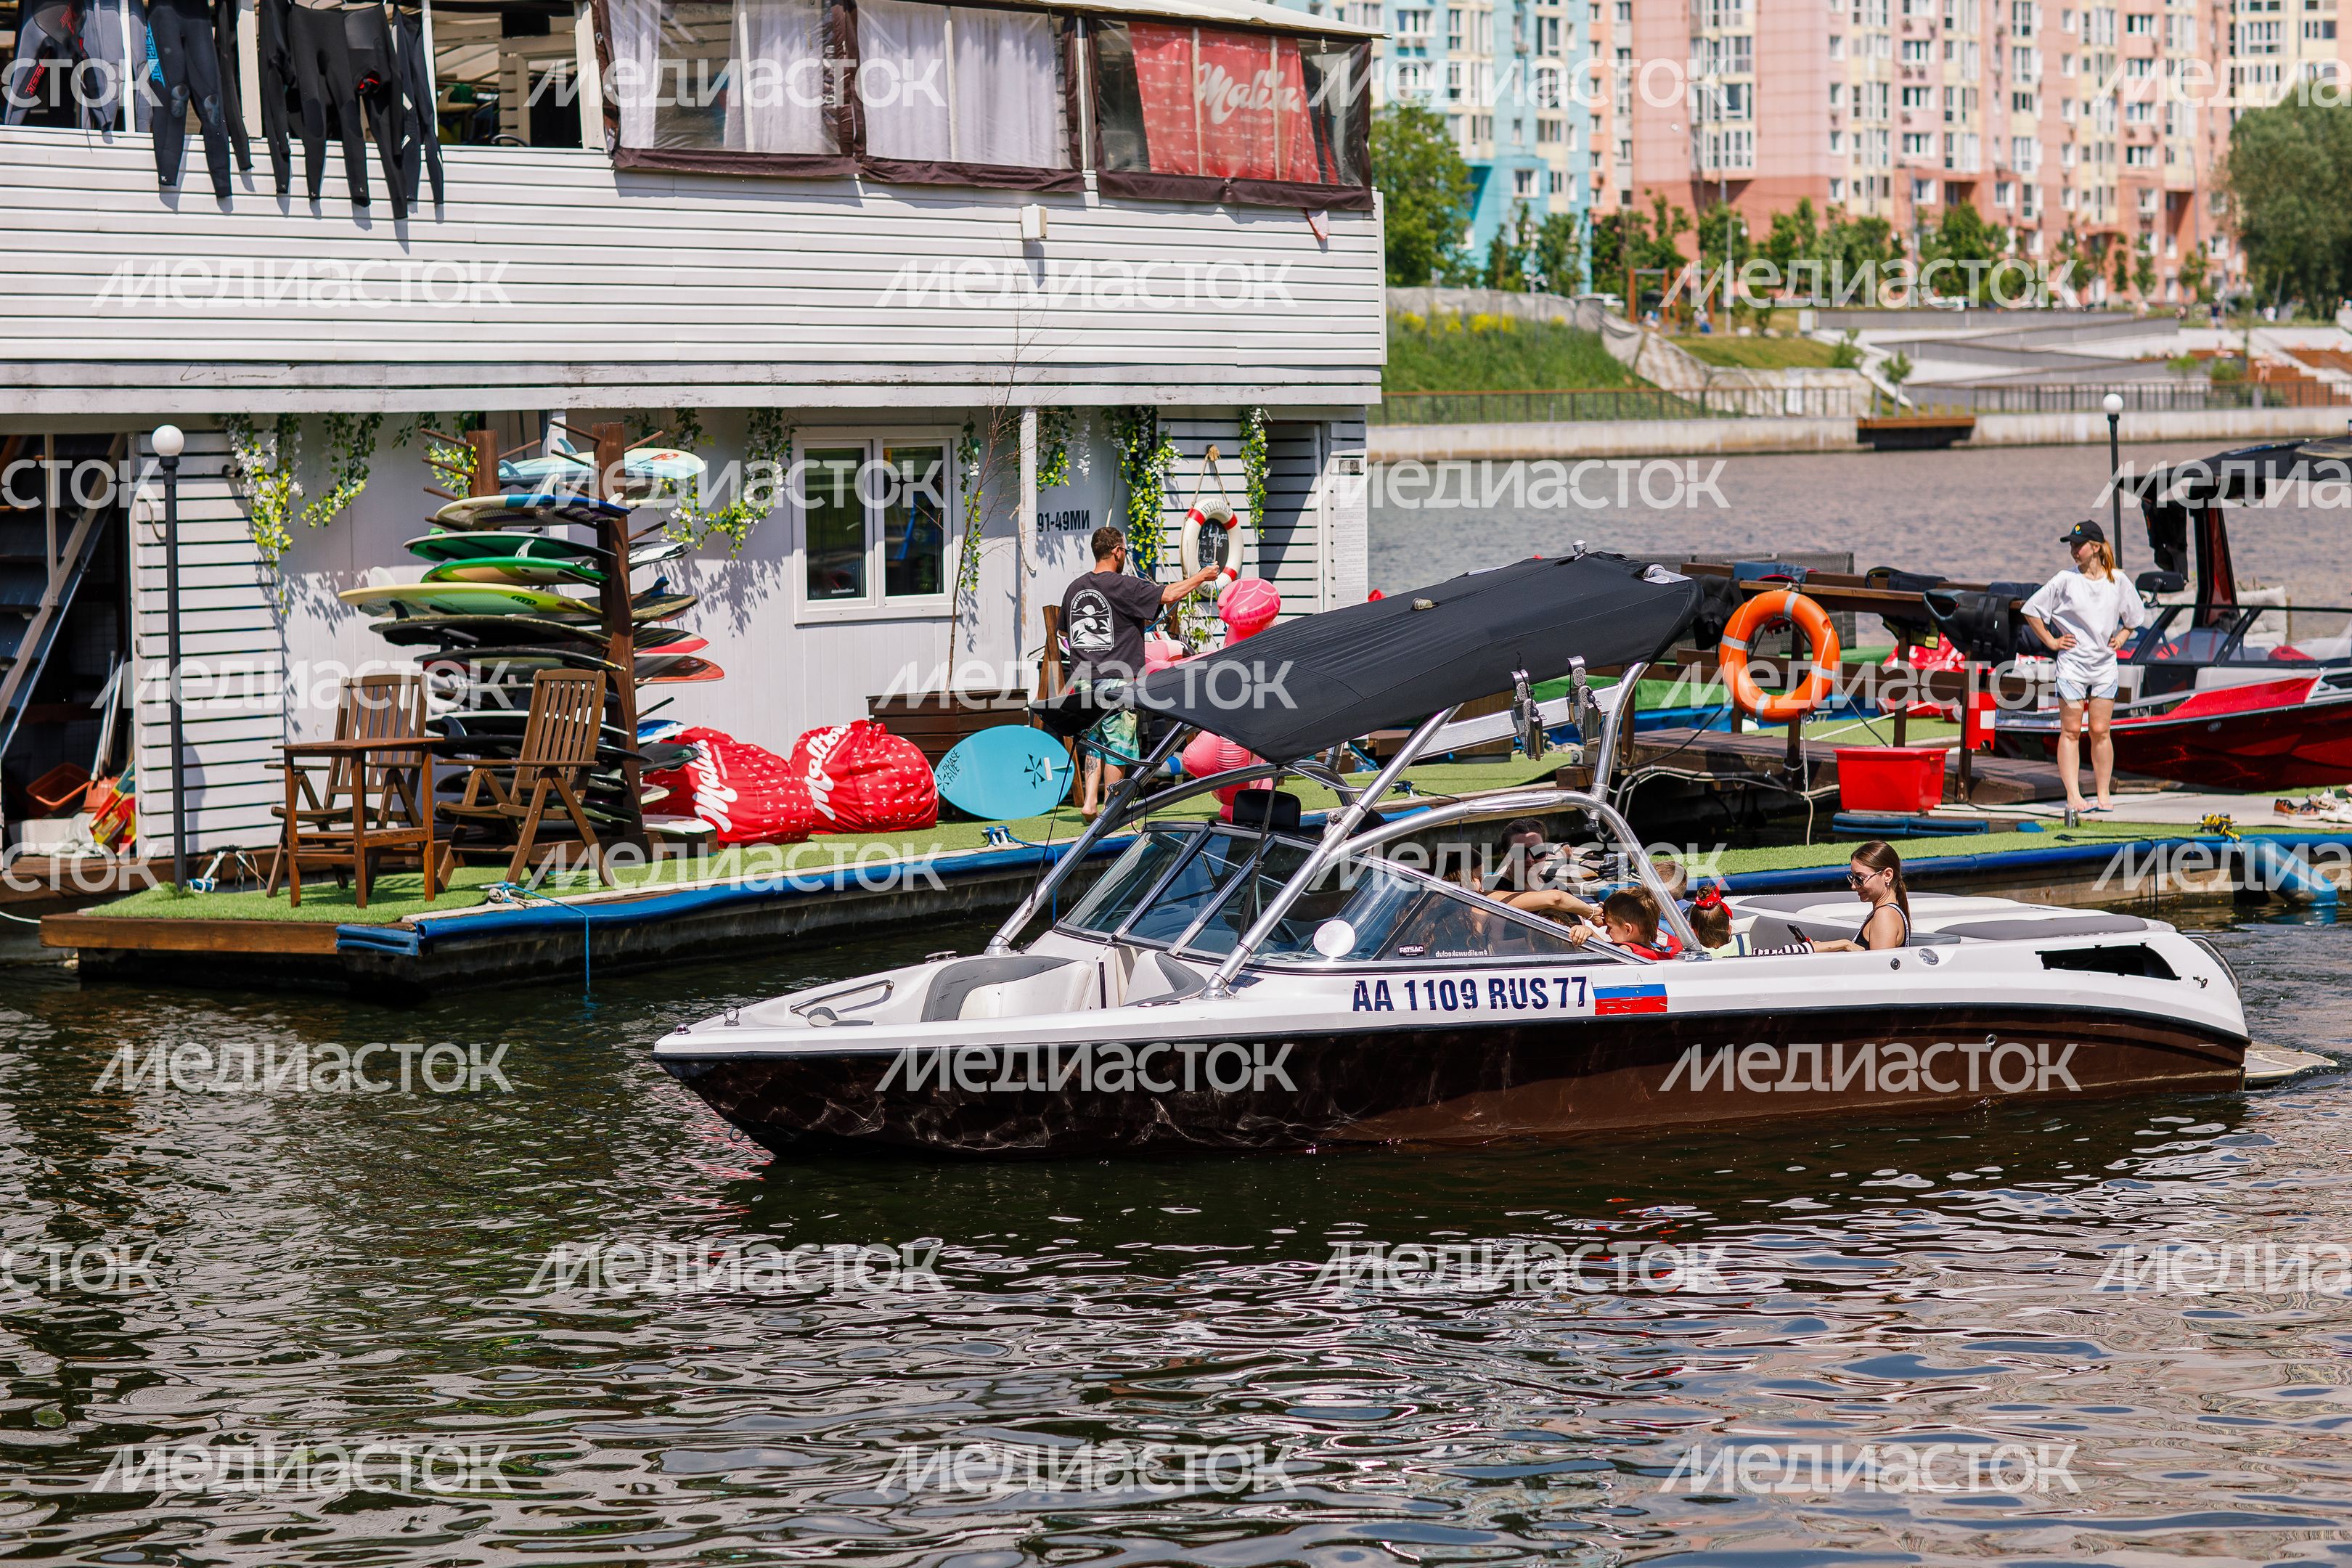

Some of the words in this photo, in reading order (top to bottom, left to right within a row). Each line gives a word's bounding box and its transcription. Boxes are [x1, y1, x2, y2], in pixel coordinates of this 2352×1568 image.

[1201, 501, 1231, 515] WELCOME
[1037, 510, 1090, 532] 91-49МИ
[942, 748, 960, 772] PHASE
[947, 763, 960, 783] FIVE
[1404, 979, 1479, 1011] 1109
